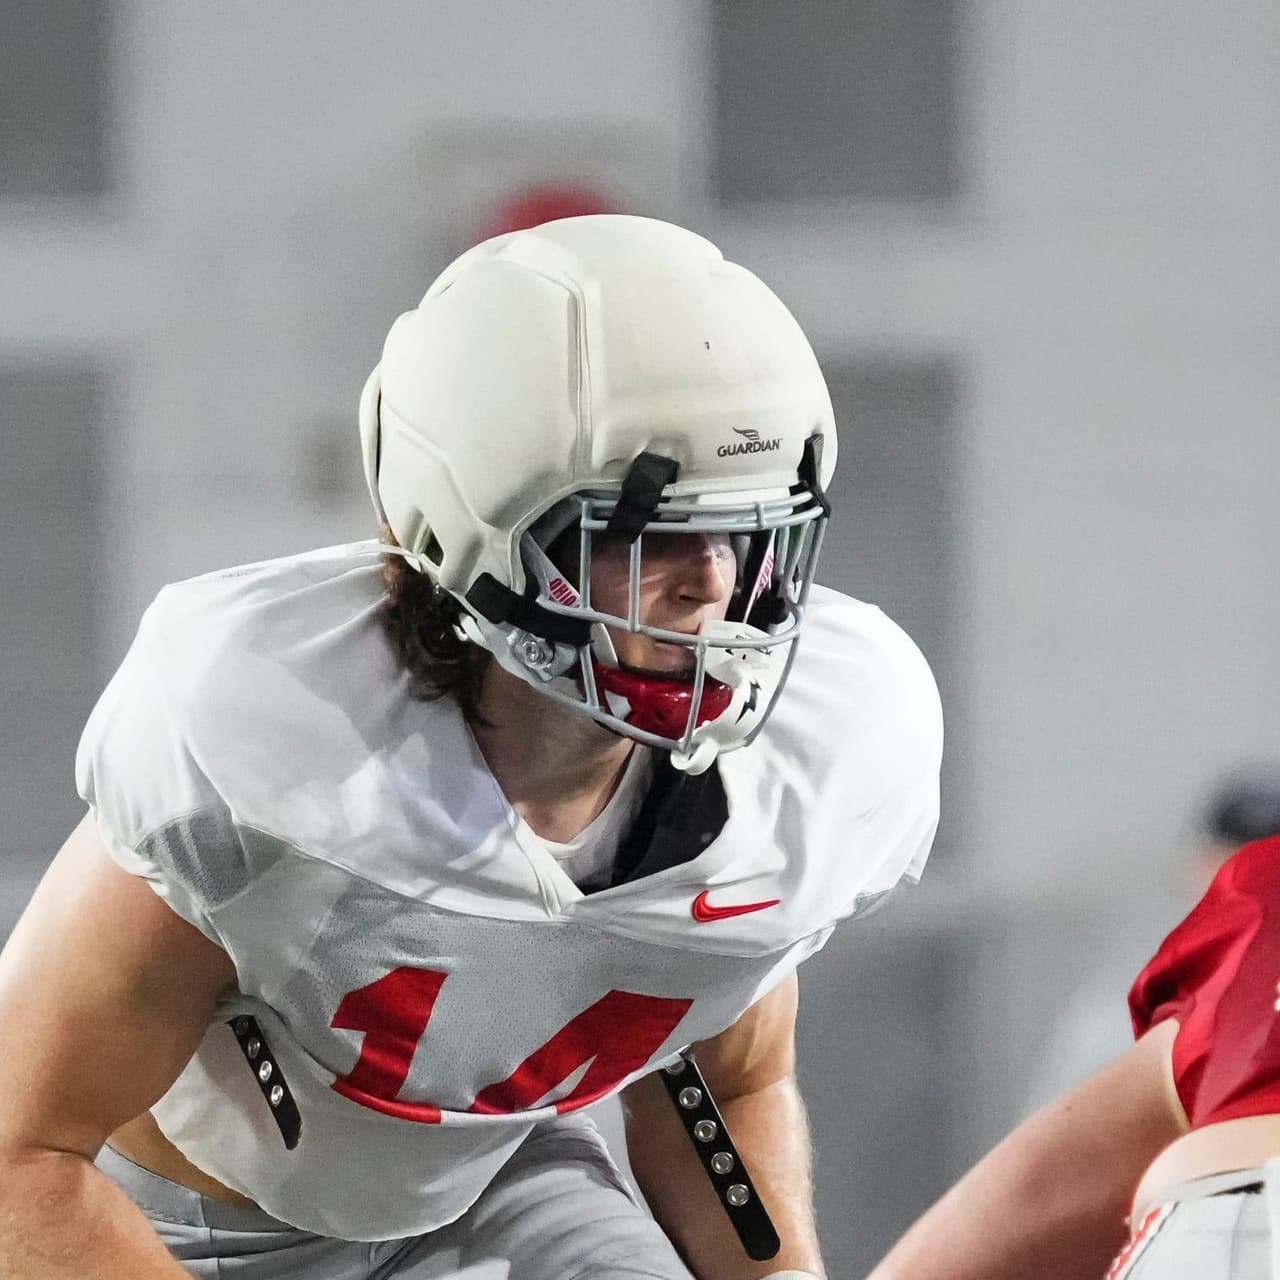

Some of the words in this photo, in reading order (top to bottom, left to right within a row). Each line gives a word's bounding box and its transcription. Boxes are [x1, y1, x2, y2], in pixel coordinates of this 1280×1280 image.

[717, 439, 780, 458] GUARDIAN
[549, 577, 578, 606] OHIO
[329, 964, 695, 1125] 14
